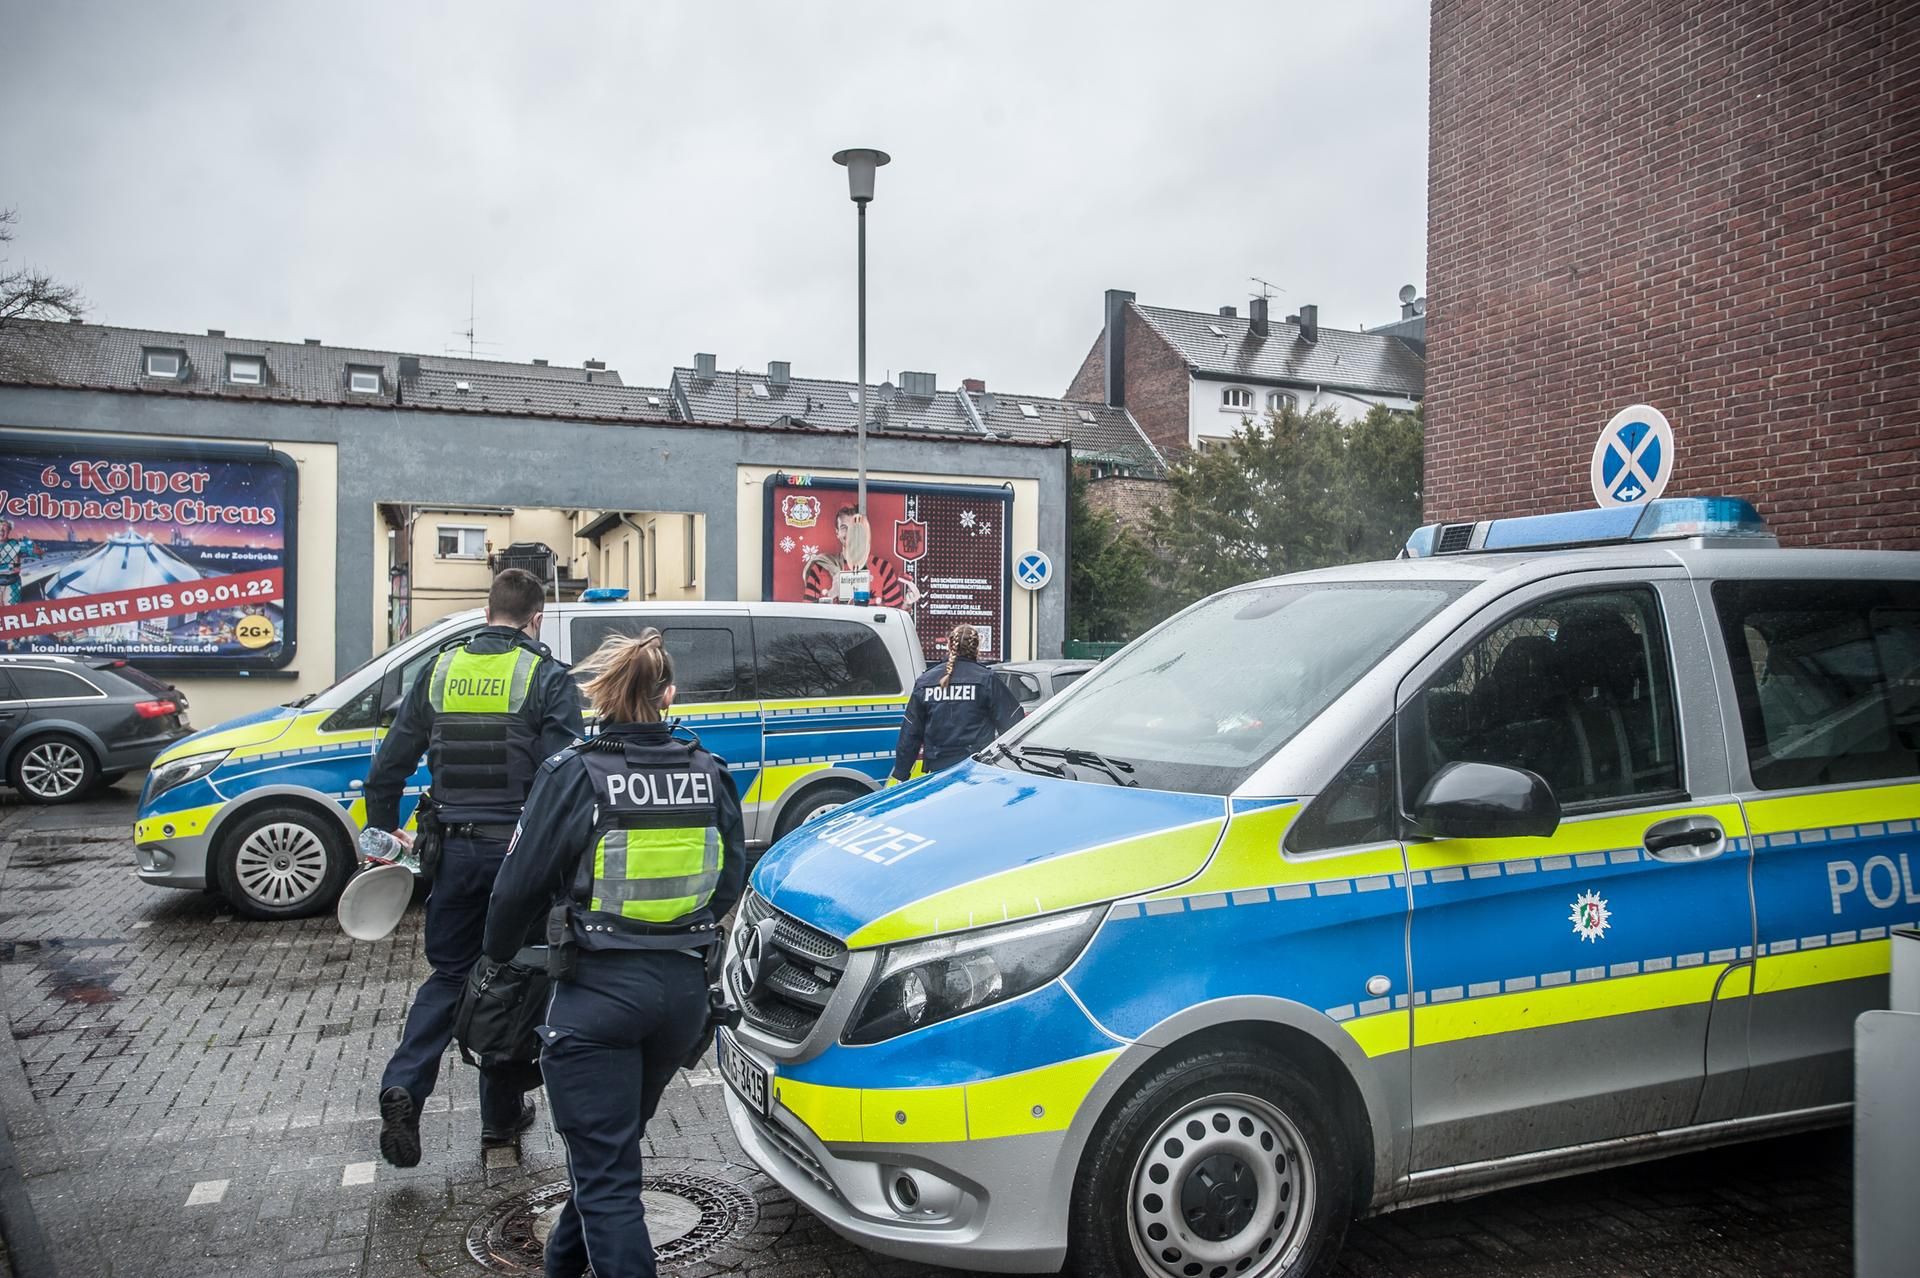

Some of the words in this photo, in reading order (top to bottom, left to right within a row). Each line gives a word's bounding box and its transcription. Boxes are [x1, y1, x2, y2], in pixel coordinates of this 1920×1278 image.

[41, 465, 71, 488] 6.
[70, 461, 210, 495] Kölner
[231, 552, 279, 561] Zoobrücke
[0, 600, 129, 631] RLÄNGERT
[136, 594, 175, 612] BIS
[180, 579, 274, 606] 09.01.22
[240, 626, 271, 637] 2G+
[31, 643, 219, 653] koelner-weihnachtscircus.de
[448, 678, 505, 696] POLIZEI
[924, 685, 976, 701] POLIZEI
[606, 772, 714, 805] POLIZEI
[809, 811, 937, 866] POLIZEI
[1827, 853, 1920, 914] POL
